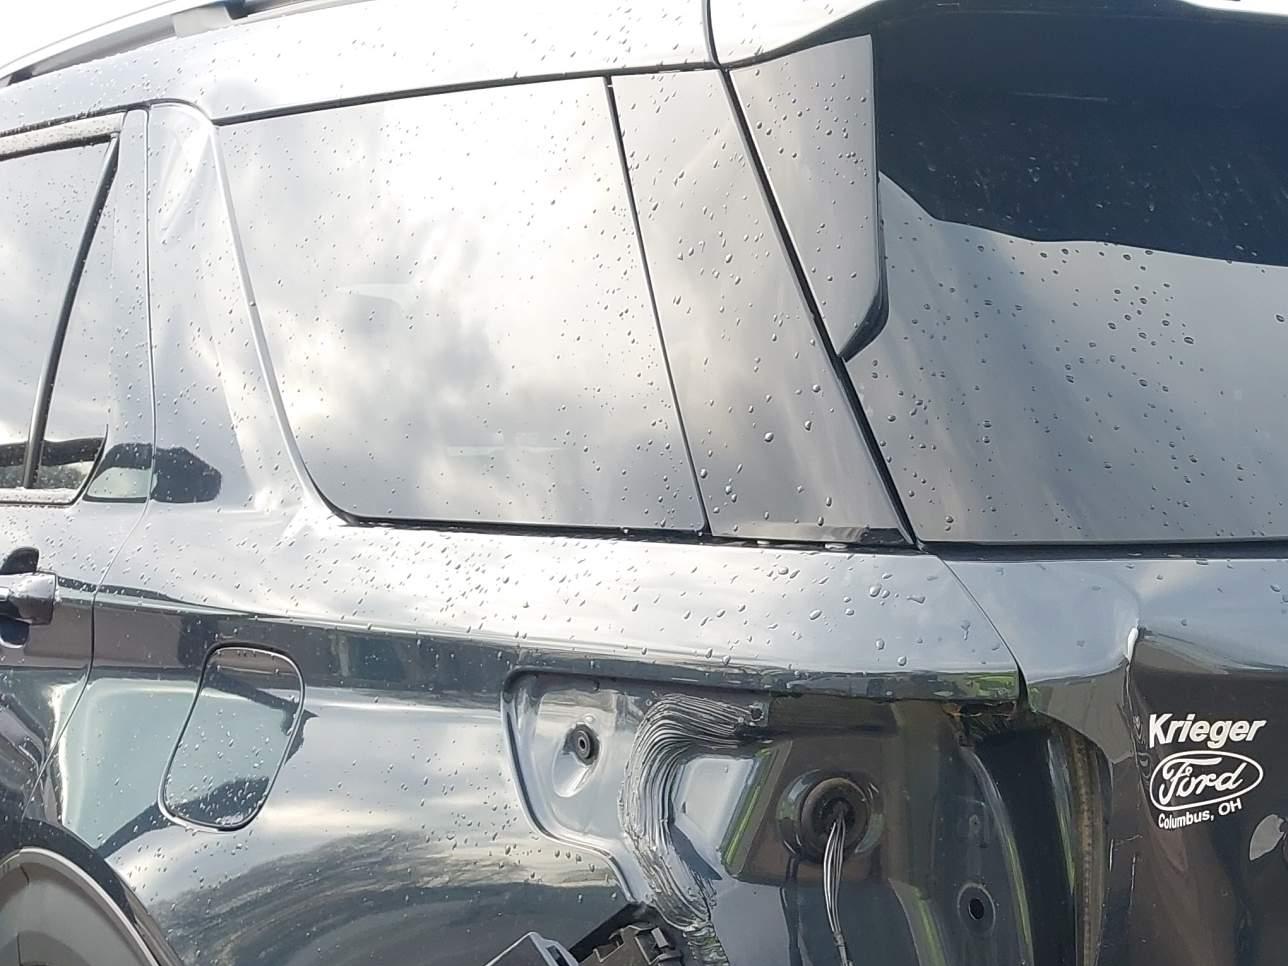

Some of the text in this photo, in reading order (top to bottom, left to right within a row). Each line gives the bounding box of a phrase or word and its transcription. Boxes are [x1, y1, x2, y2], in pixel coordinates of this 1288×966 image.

[1149, 713, 1267, 749] Krieger
[1158, 757, 1248, 805] Ford
[1158, 798, 1243, 830] Columbus, OH
